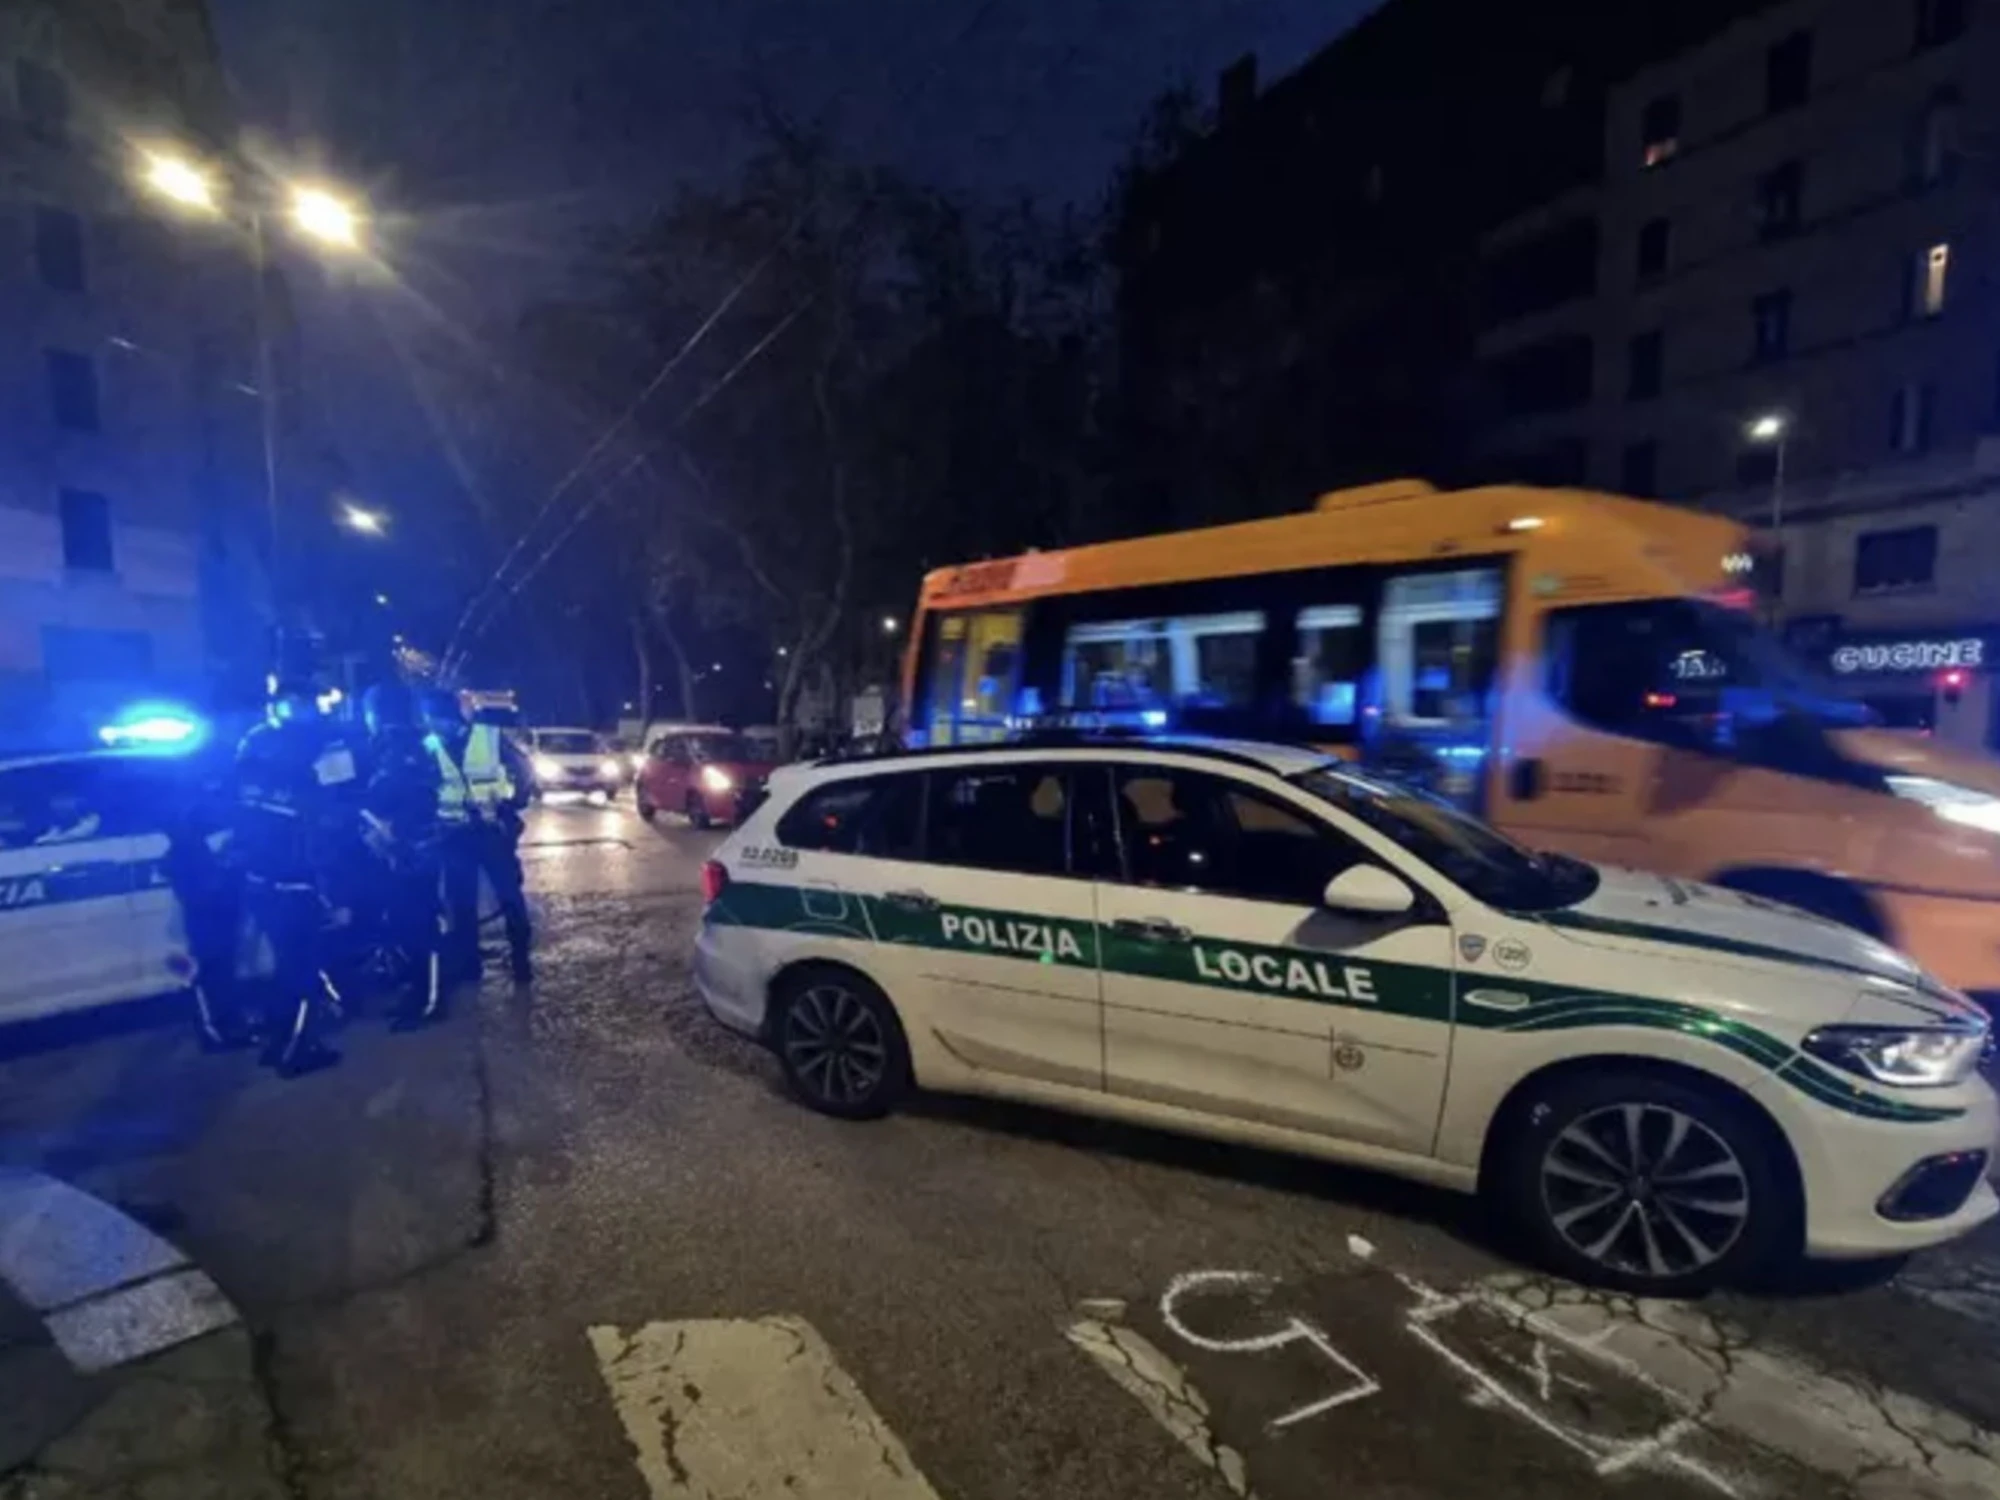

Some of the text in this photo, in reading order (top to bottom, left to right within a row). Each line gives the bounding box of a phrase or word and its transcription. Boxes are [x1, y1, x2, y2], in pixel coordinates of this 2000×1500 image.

[1831, 638, 1983, 673] CUCINE
[940, 913, 1379, 1003] POLIZIA LOCALE
